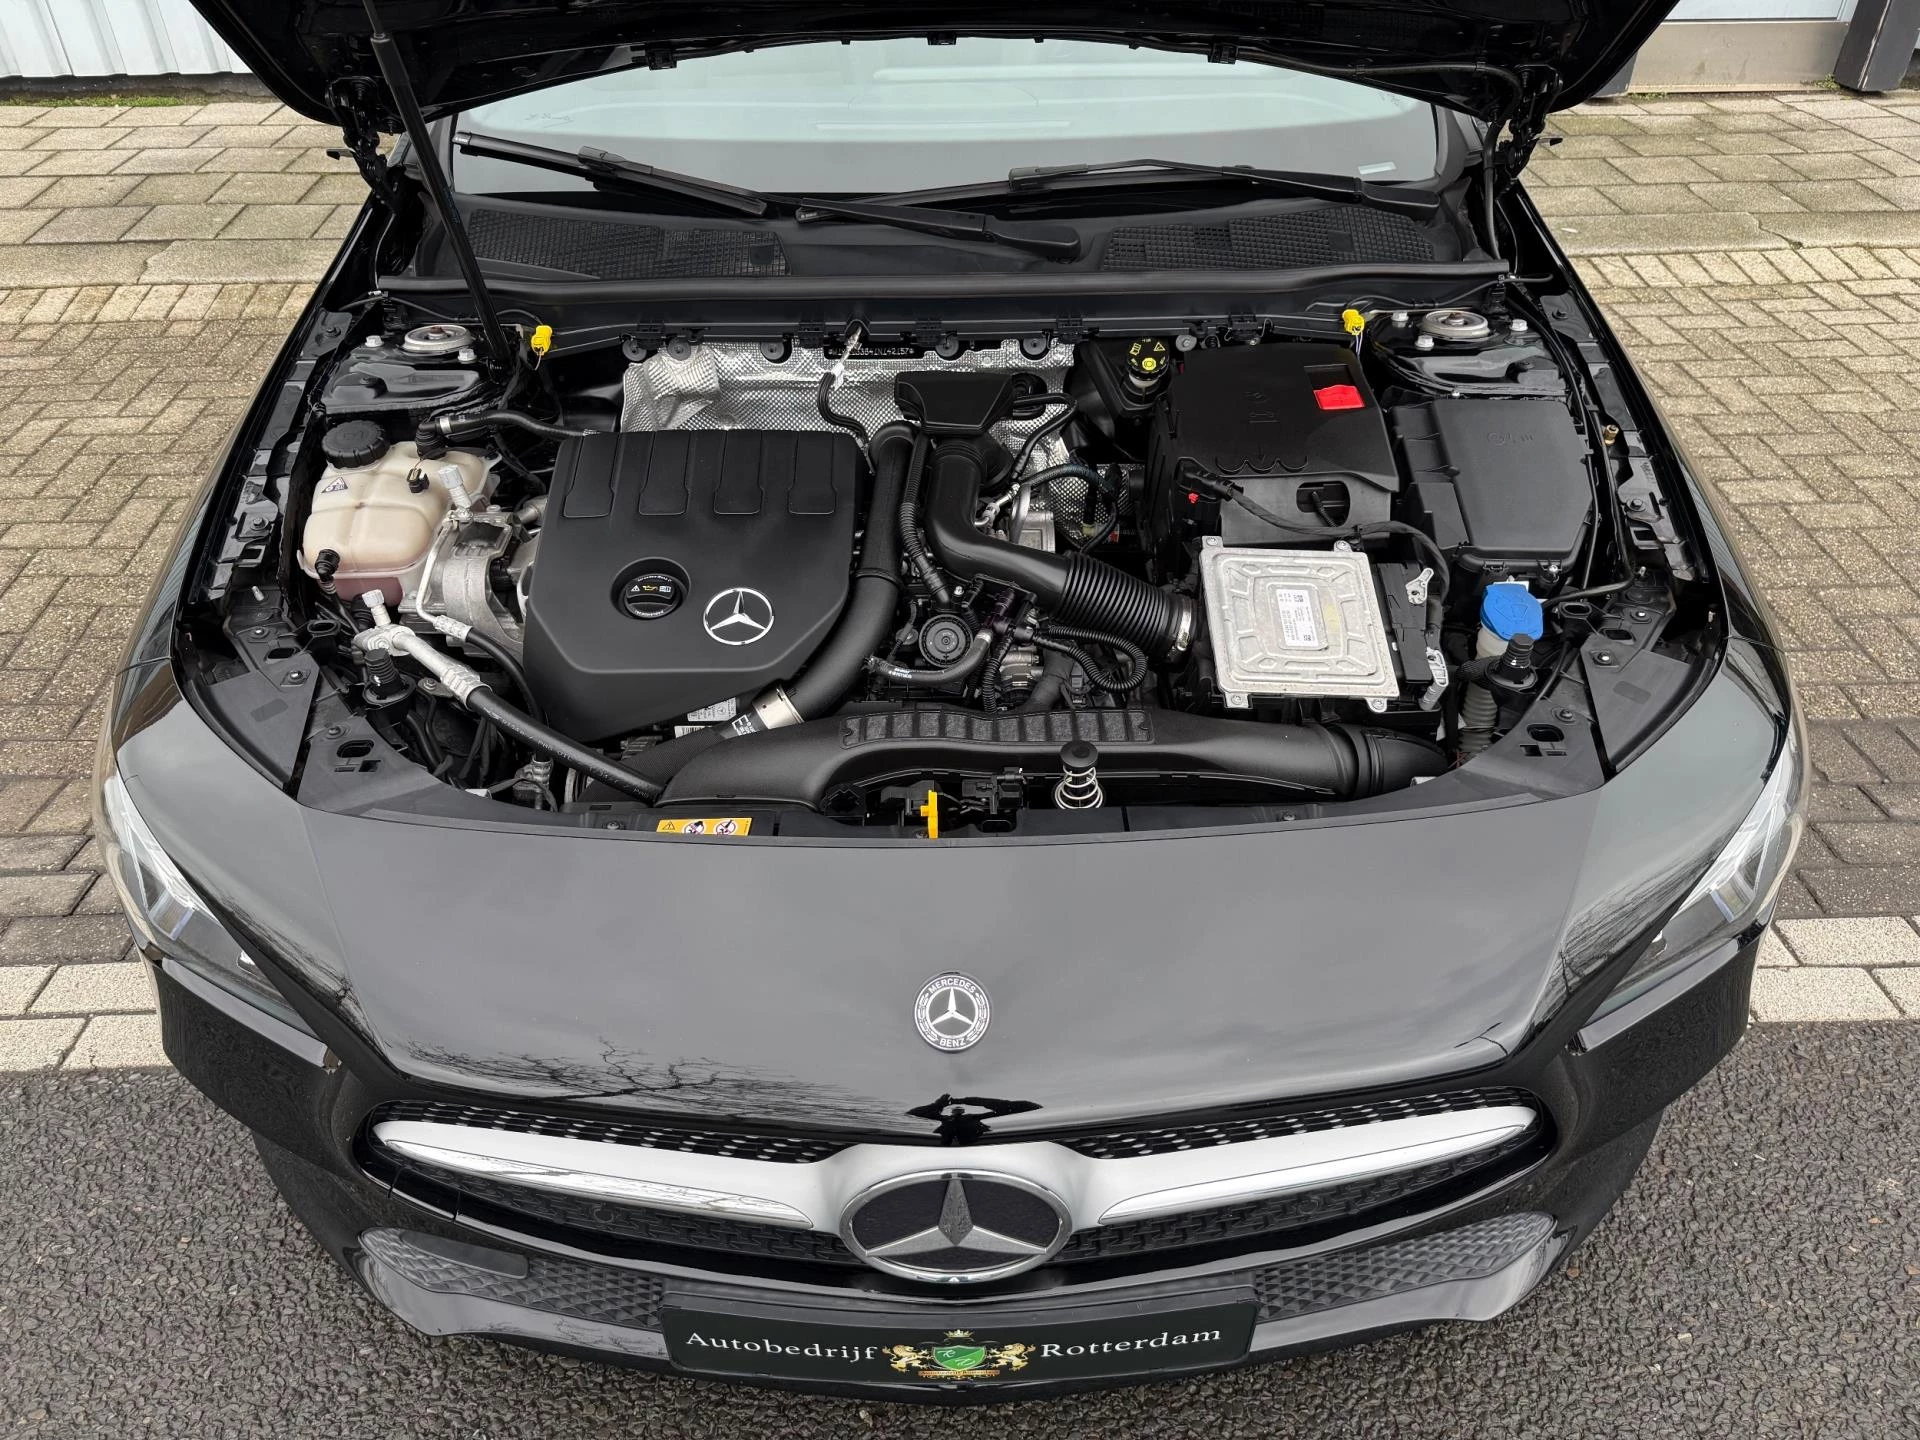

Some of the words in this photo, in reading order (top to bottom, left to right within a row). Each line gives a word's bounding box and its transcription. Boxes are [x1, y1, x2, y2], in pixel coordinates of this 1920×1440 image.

[928, 978, 976, 994] MERCEDES
[940, 1037, 967, 1048] BENZ
[685, 1332, 879, 1363] Autobedrijf
[1040, 1329, 1221, 1358] Rotterdam
